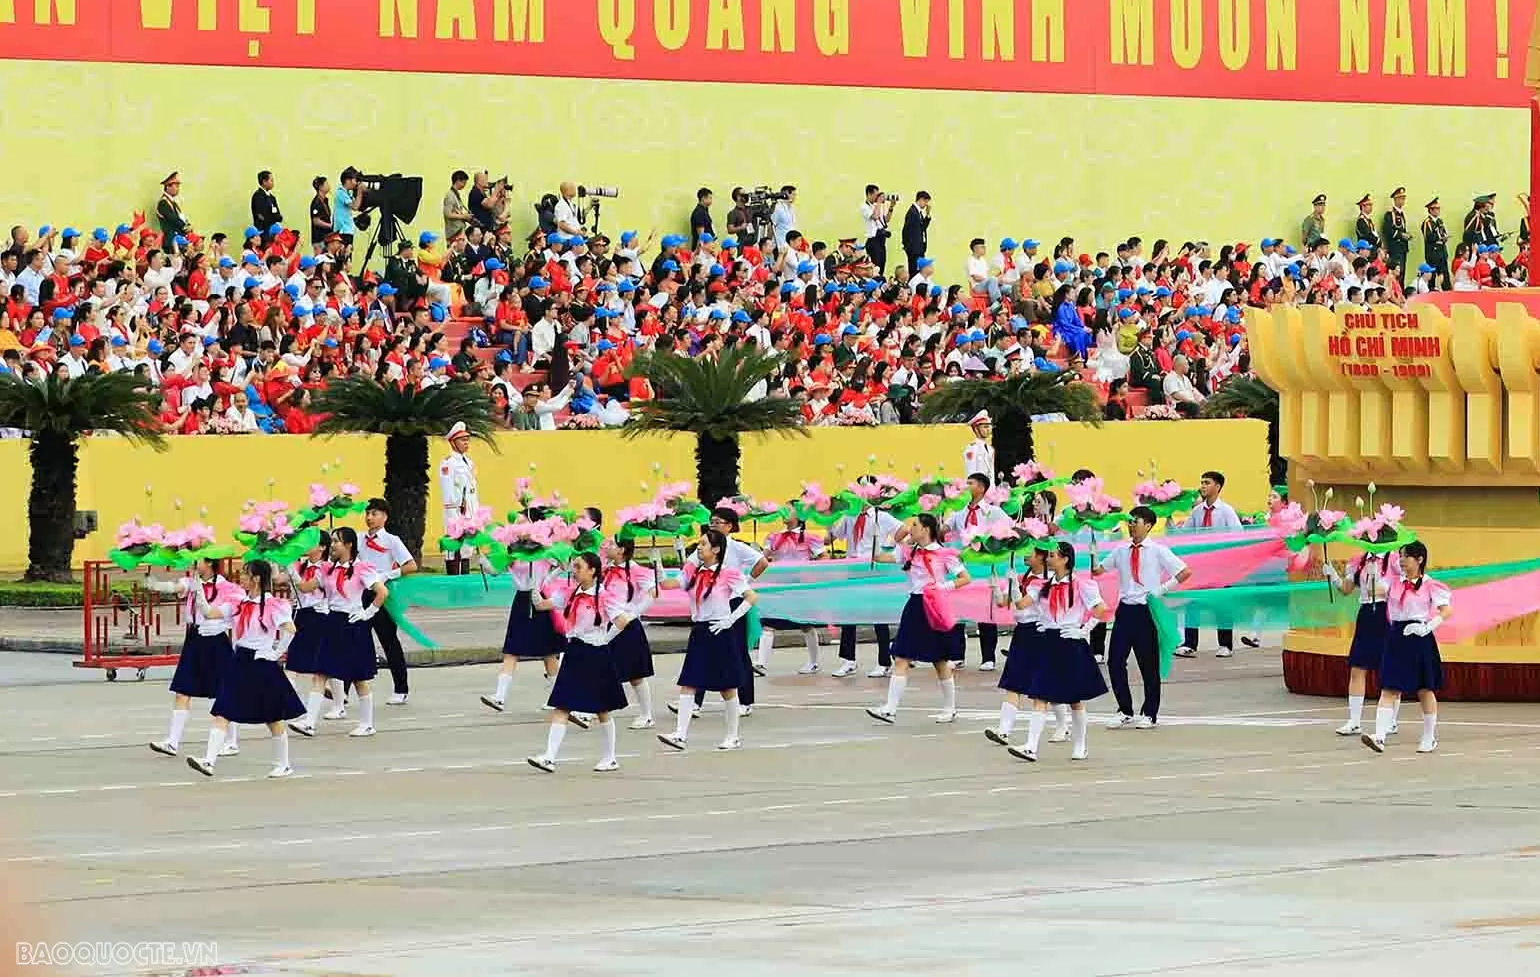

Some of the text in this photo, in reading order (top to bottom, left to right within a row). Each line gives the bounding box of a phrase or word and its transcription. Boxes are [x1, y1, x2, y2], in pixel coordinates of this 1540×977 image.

[1380, 313, 1419, 332] TỊCH
[1328, 328, 1441, 358] HỒ CHÍ MINH
